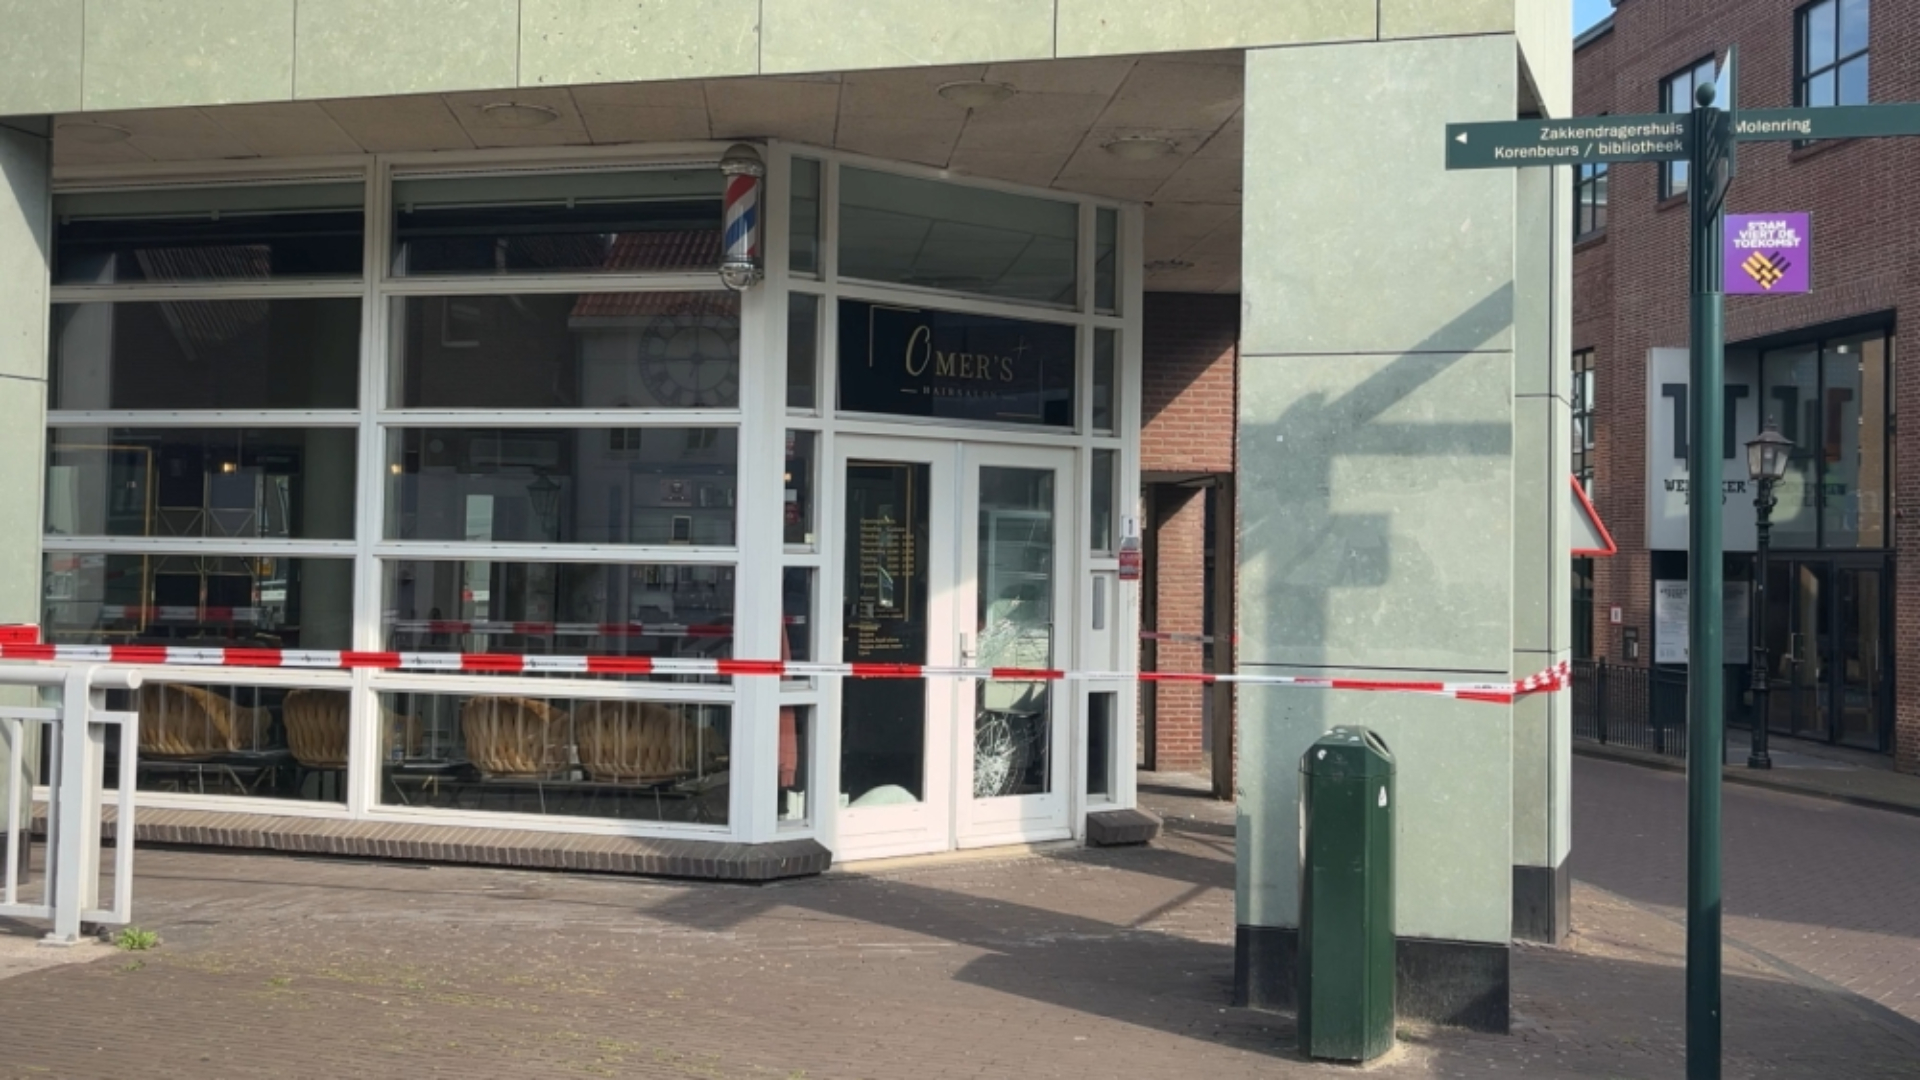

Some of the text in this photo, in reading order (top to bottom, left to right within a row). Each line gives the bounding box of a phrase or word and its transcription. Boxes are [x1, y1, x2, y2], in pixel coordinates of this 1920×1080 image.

[1540, 122, 1684, 140] Zakkendragershuis
[1736, 119, 1811, 134] Molenring
[1495, 140, 1683, 159] Korenbeurs / bibliotheek
[1739, 229, 1795, 239] VIERT DE
[1734, 238, 1801, 248] TOEKOMST
